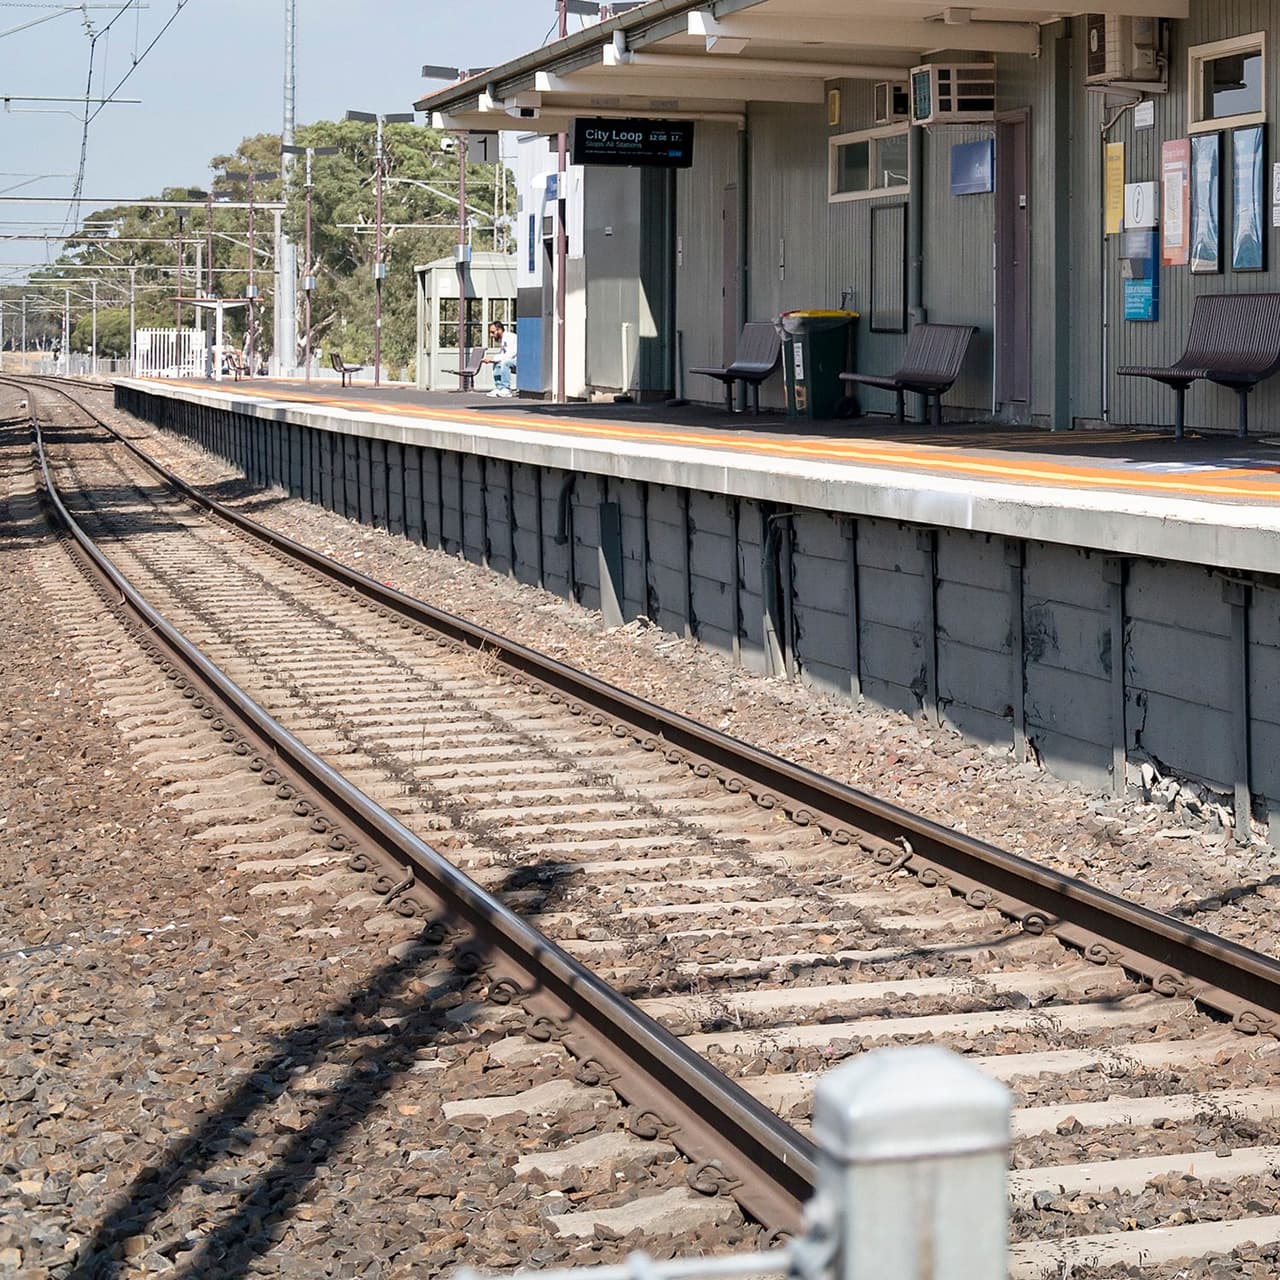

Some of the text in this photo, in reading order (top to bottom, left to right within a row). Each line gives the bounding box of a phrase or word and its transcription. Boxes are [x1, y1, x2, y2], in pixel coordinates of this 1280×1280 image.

[585, 128, 643, 143] City Loop
[477, 136, 488, 162] 1
